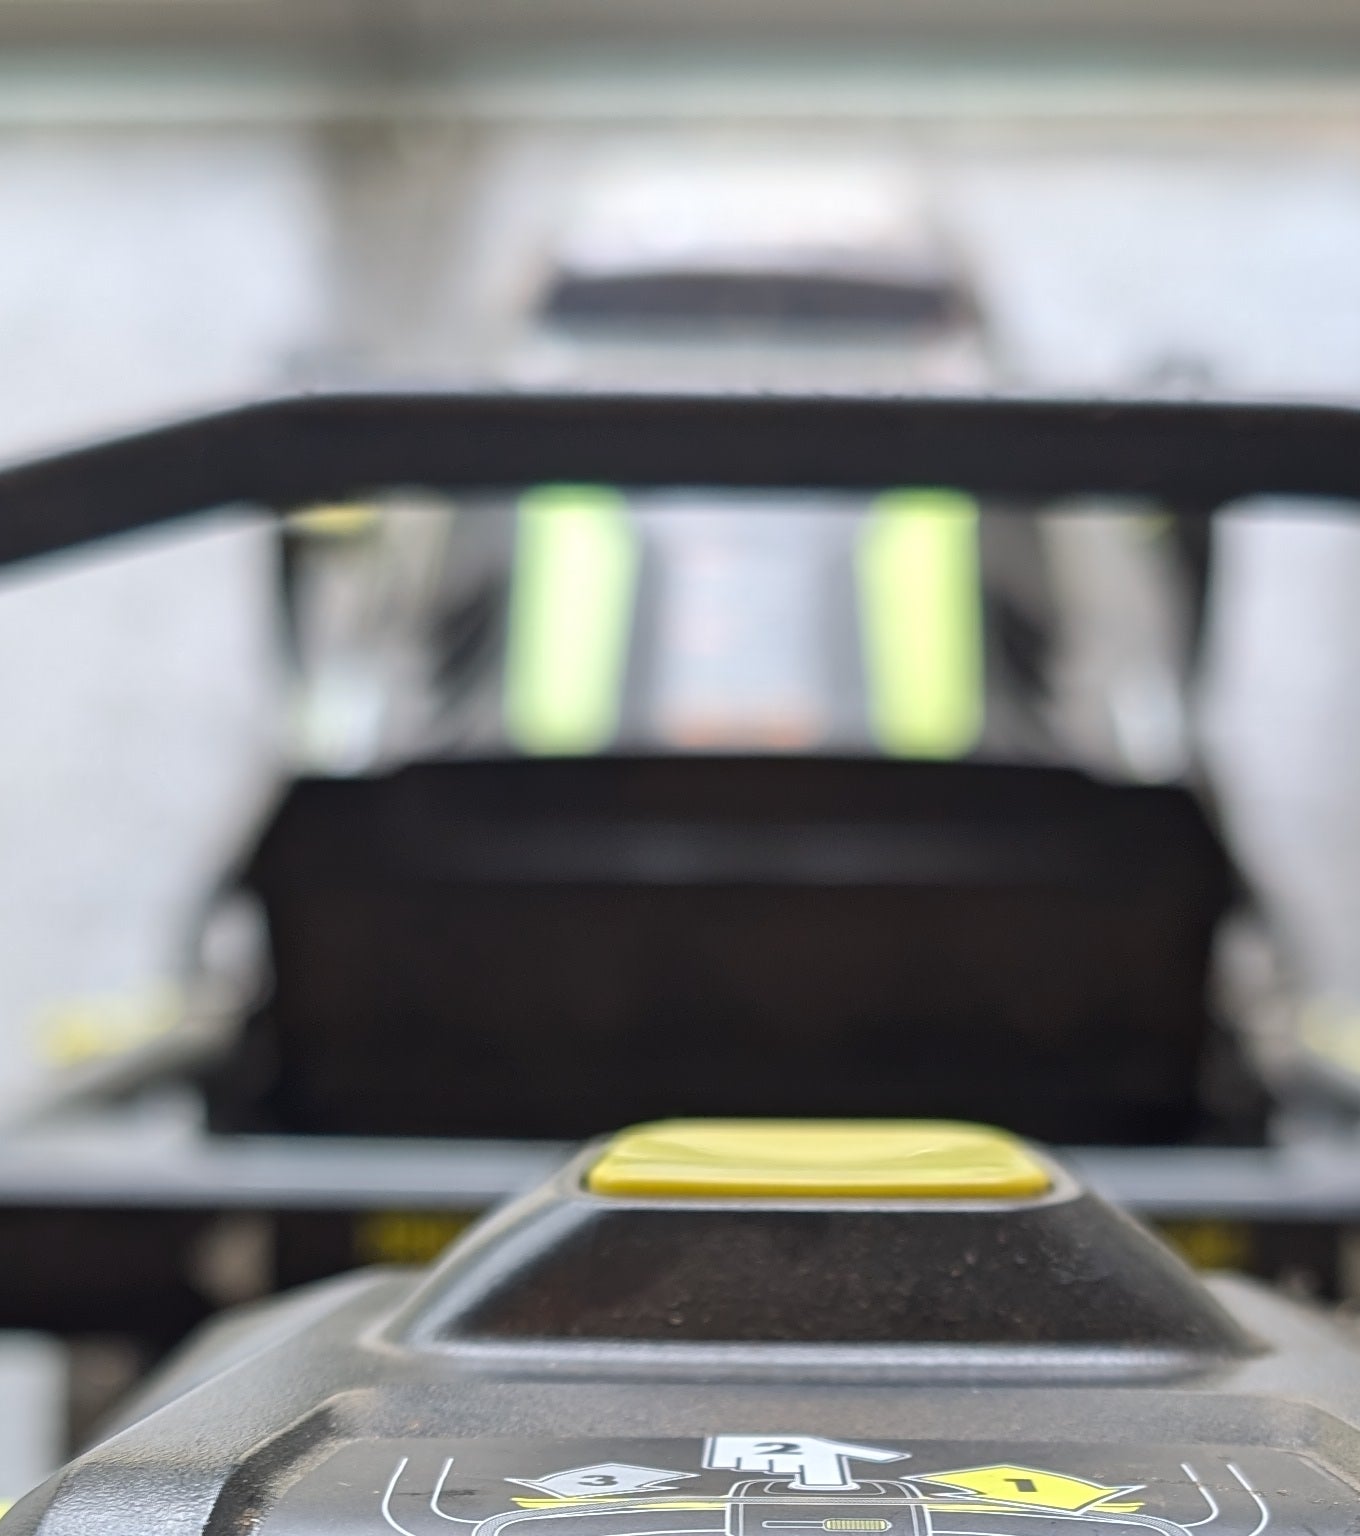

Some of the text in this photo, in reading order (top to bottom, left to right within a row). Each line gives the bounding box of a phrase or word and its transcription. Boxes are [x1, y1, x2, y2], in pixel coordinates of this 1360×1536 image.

[754, 1441, 801, 1456] 2
[579, 1475, 619, 1487] 3
[1004, 1478, 1038, 1493] 1
